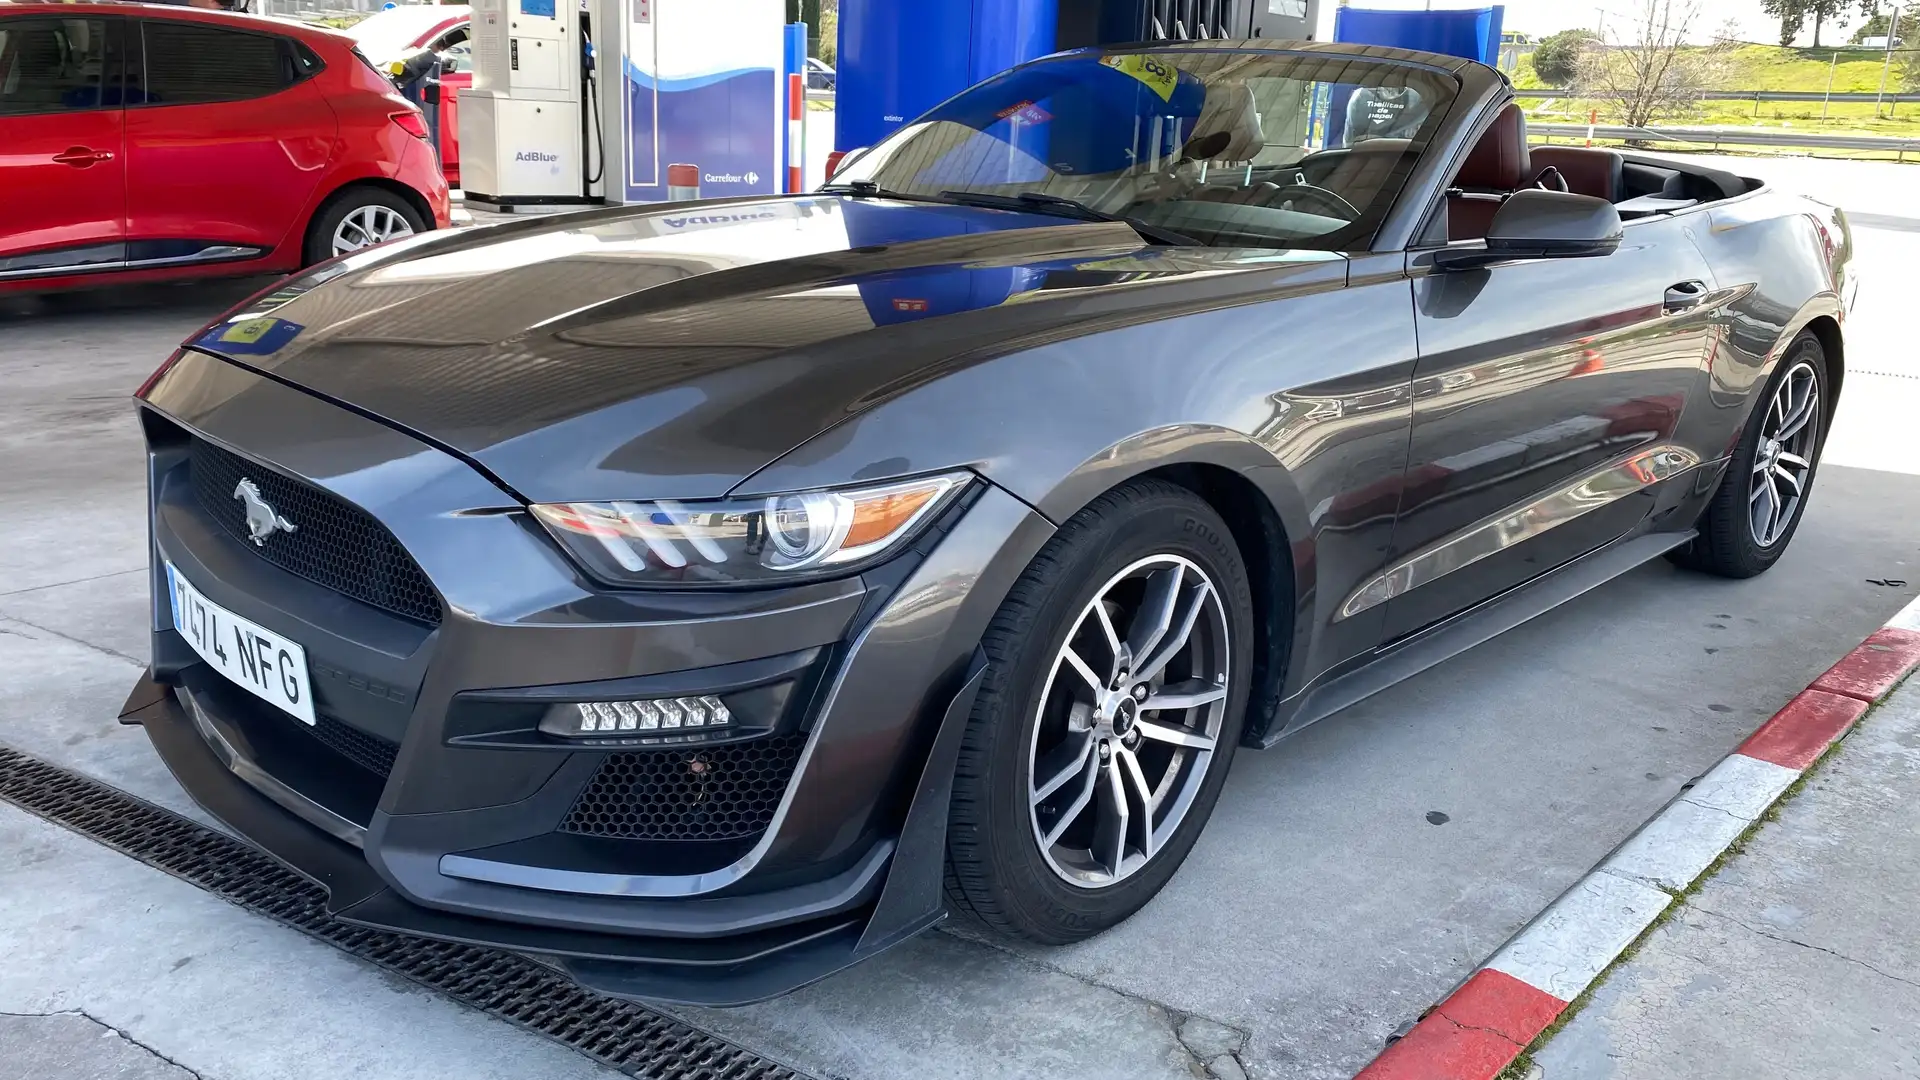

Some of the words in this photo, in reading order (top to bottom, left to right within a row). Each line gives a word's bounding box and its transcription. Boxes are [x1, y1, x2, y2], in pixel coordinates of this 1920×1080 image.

[515, 152, 558, 162] AdBlue
[704, 173, 742, 183] Carrefour
[177, 580, 228, 668] 7474
[234, 624, 299, 705] NFG
